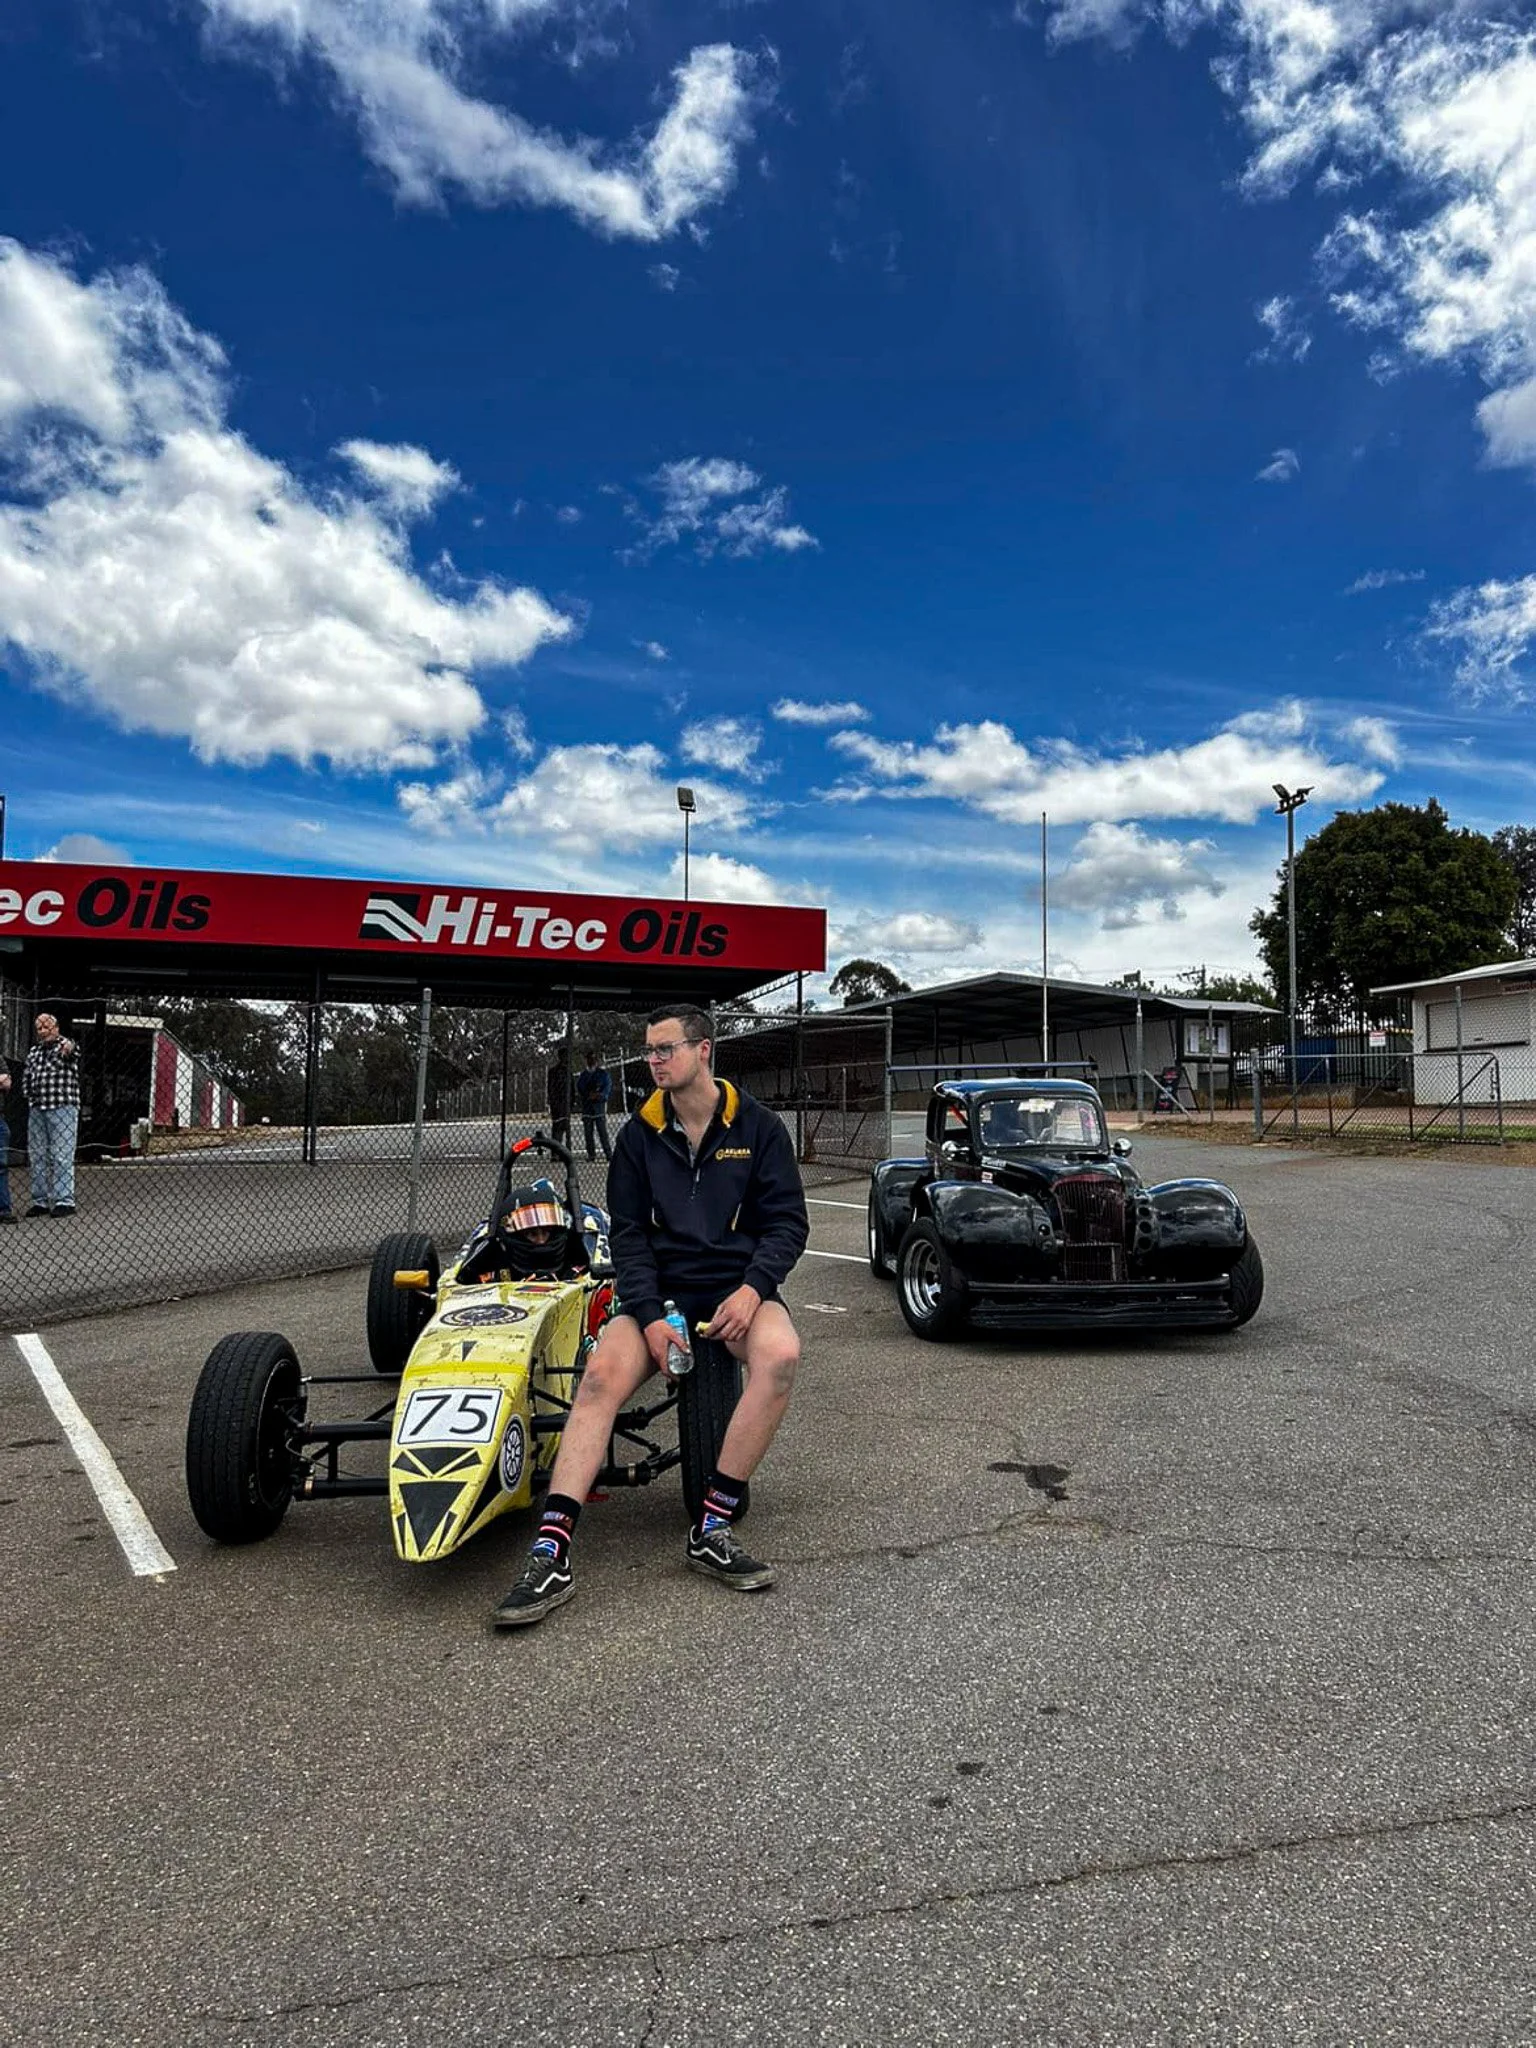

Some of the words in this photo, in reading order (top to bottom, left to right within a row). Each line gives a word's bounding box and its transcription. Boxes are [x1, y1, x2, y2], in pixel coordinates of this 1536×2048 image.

[76, 877, 211, 931] Oils
[421, 895, 607, 951] Hi-Tec
[619, 908, 730, 957] Oils
[409, 1394, 493, 1436] 75
